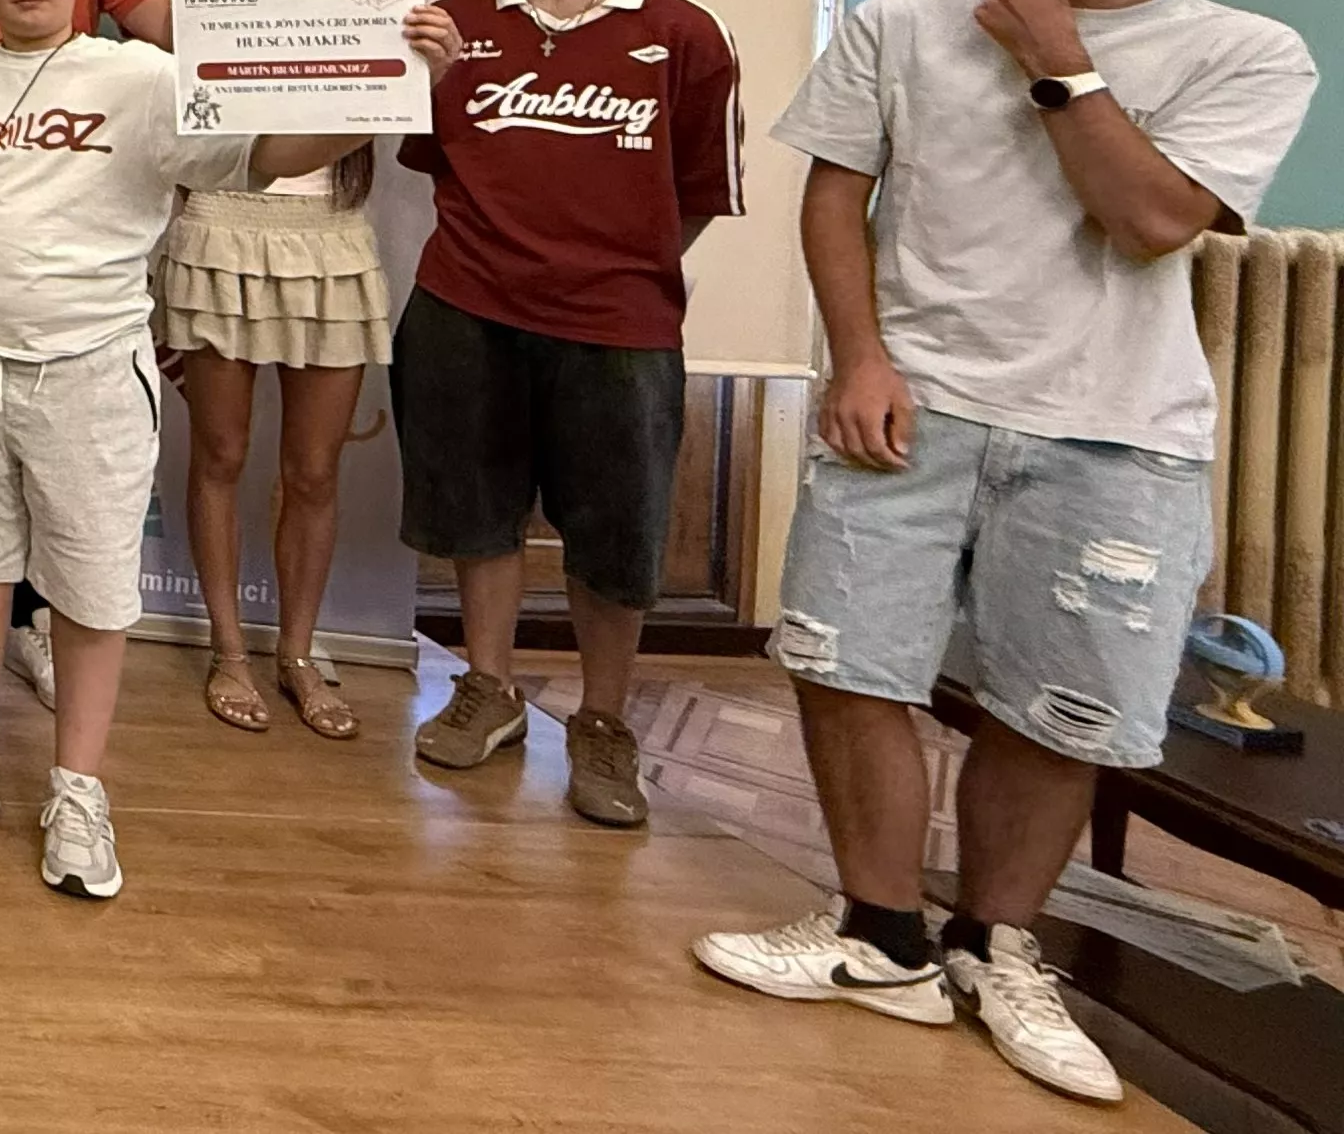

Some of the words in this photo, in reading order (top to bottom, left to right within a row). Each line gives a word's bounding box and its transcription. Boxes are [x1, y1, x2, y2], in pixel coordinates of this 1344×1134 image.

[217, 20, 271, 30] MUESTRA
[274, 19, 324, 29] JÓVENES
[327, 17, 397, 28] CREADORES
[237, 36, 294, 48] HUESCA
[299, 34, 360, 47] MAKERS
[227, 66, 269, 76] MARTÍN
[466, 72, 658, 134] Ambling
